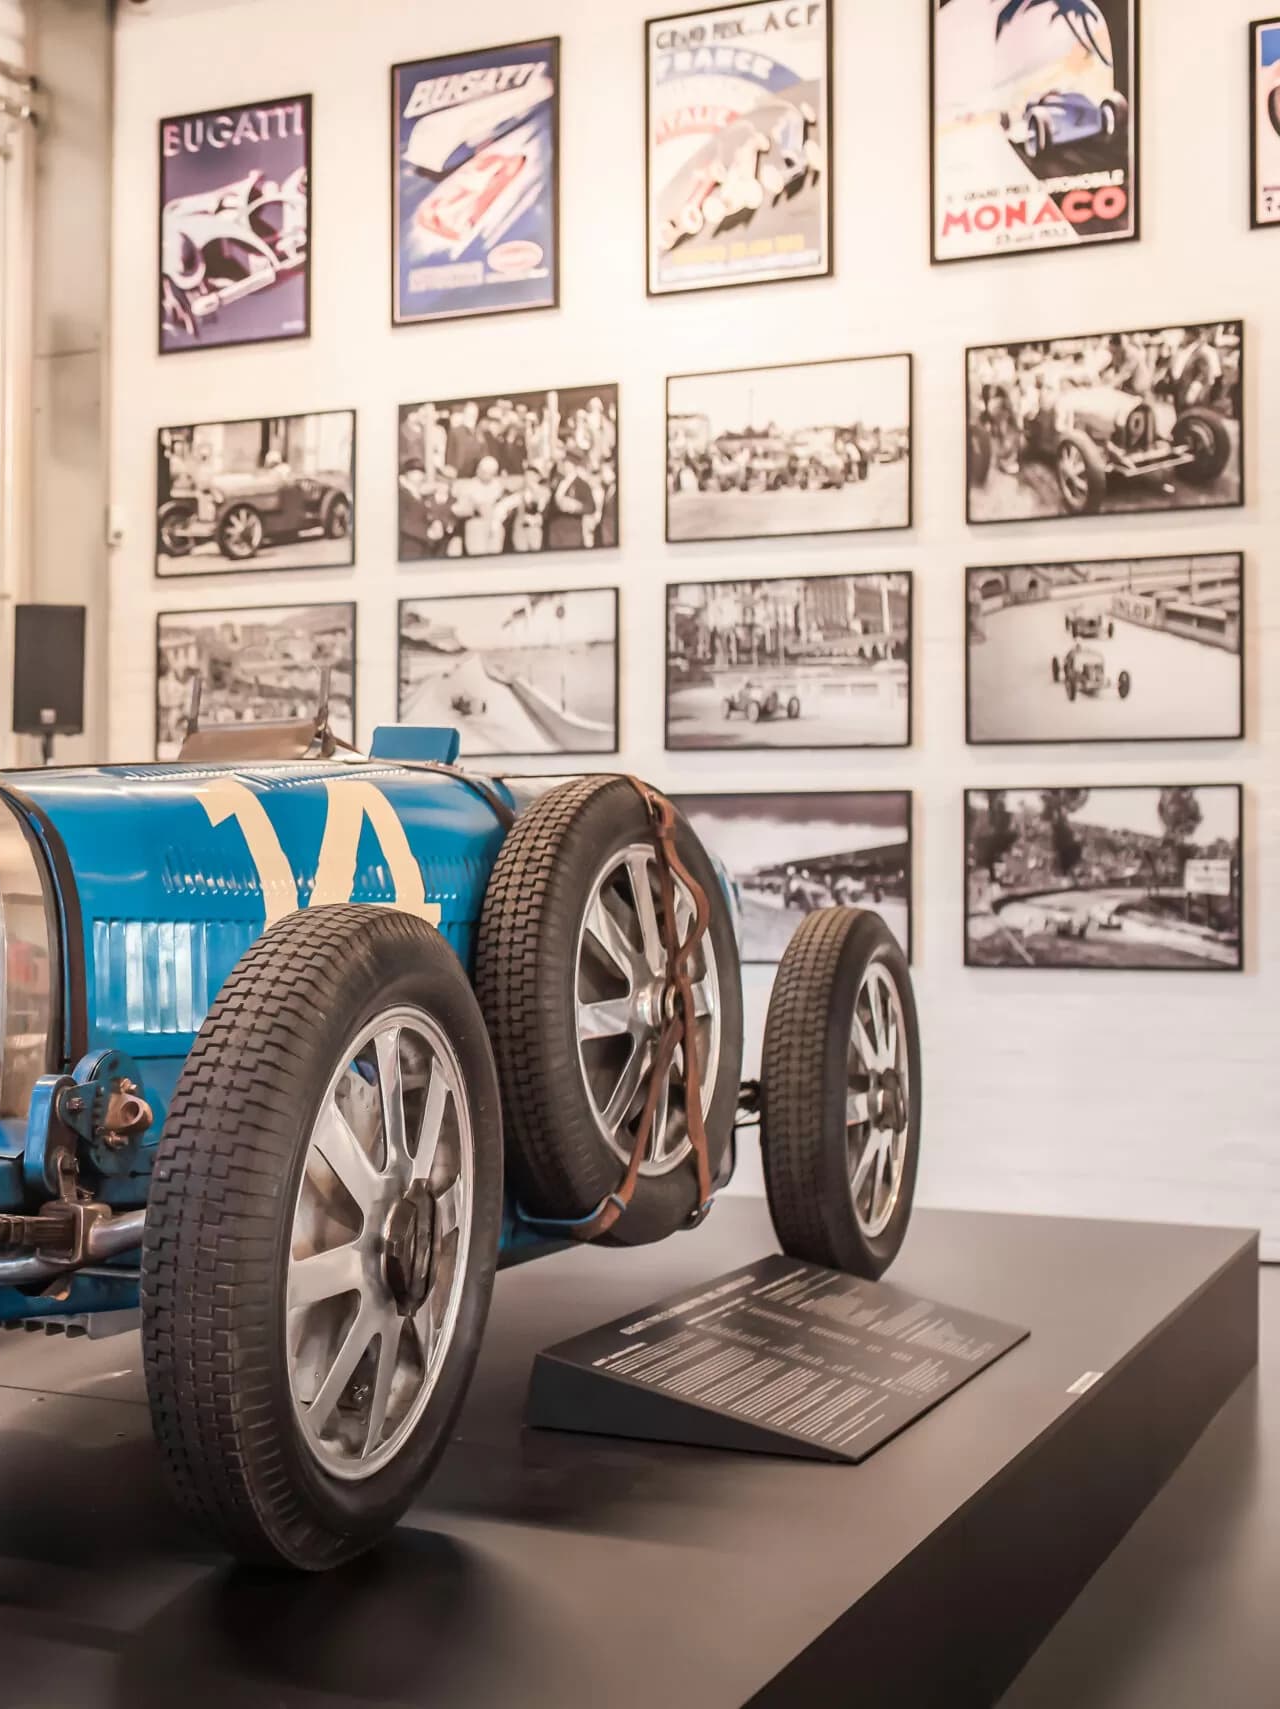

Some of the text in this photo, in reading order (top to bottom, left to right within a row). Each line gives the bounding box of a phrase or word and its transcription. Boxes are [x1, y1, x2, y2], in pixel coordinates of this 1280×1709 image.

[404, 61, 547, 119] BUGATTI
[163, 102, 303, 157] BUGATTI
[942, 186, 1126, 236] MONACO
[193, 778, 441, 933] 14
